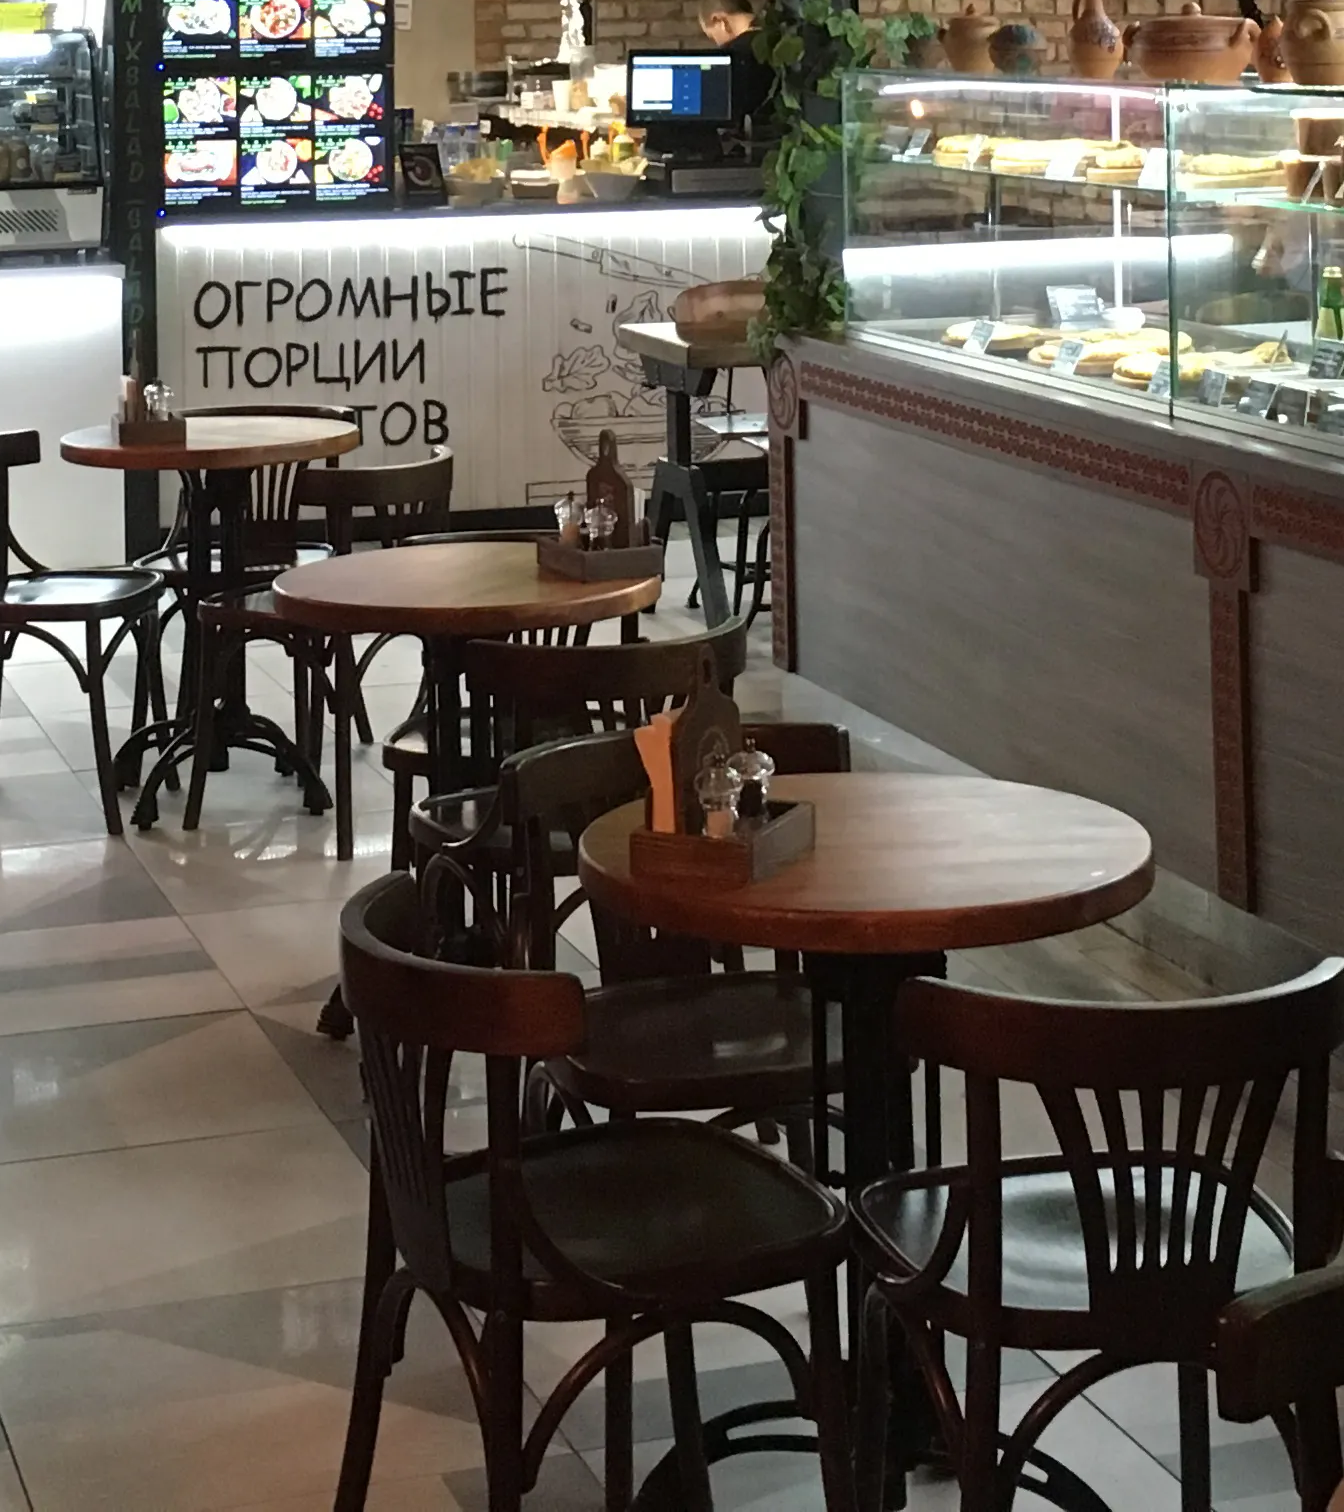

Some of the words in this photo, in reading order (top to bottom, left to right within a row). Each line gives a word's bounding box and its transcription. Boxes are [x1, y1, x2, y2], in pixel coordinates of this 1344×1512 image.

[193, 266, 509, 330] ОГРОМНЫЕ
[195, 337, 426, 392] ПОРЦИИ
[345, 398, 451, 447] ТОВ
